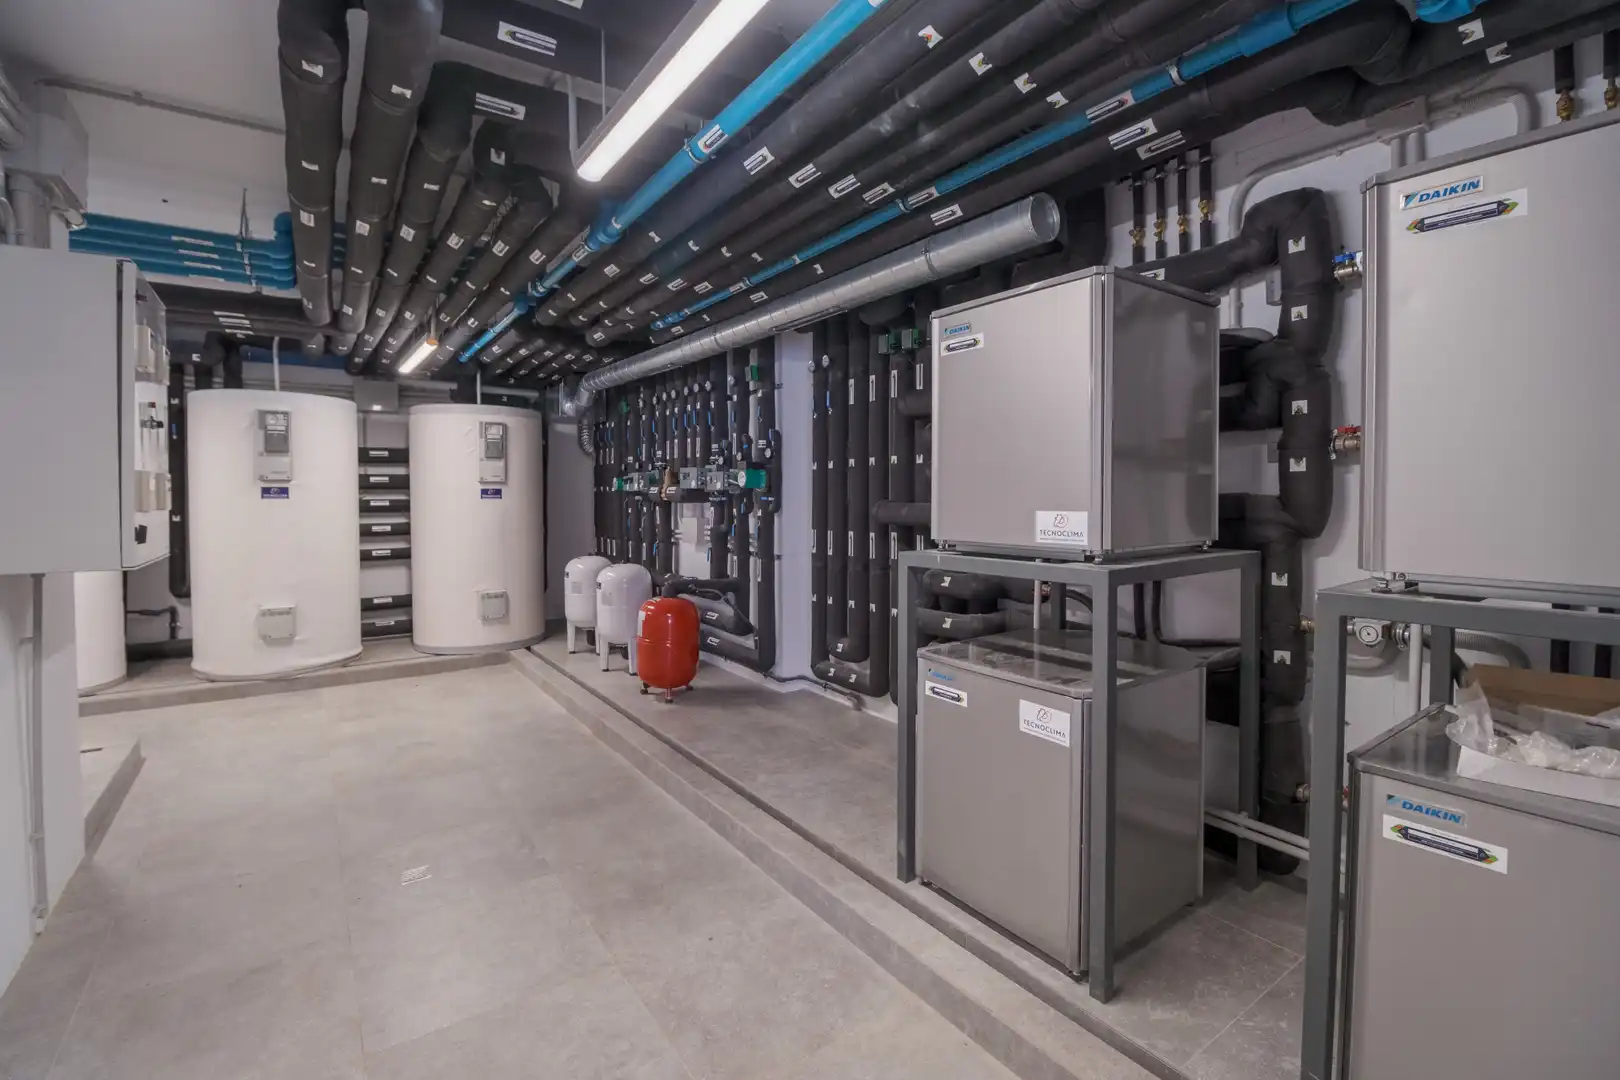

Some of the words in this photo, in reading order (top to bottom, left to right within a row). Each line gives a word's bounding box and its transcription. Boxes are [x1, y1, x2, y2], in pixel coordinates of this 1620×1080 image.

[1418, 179, 1481, 203] DAIKIN
[1039, 529, 1084, 538] TECNOCLIMA
[1023, 718, 1066, 738] TECNOCLIMA
[1402, 800, 1462, 824] DAIKIN
